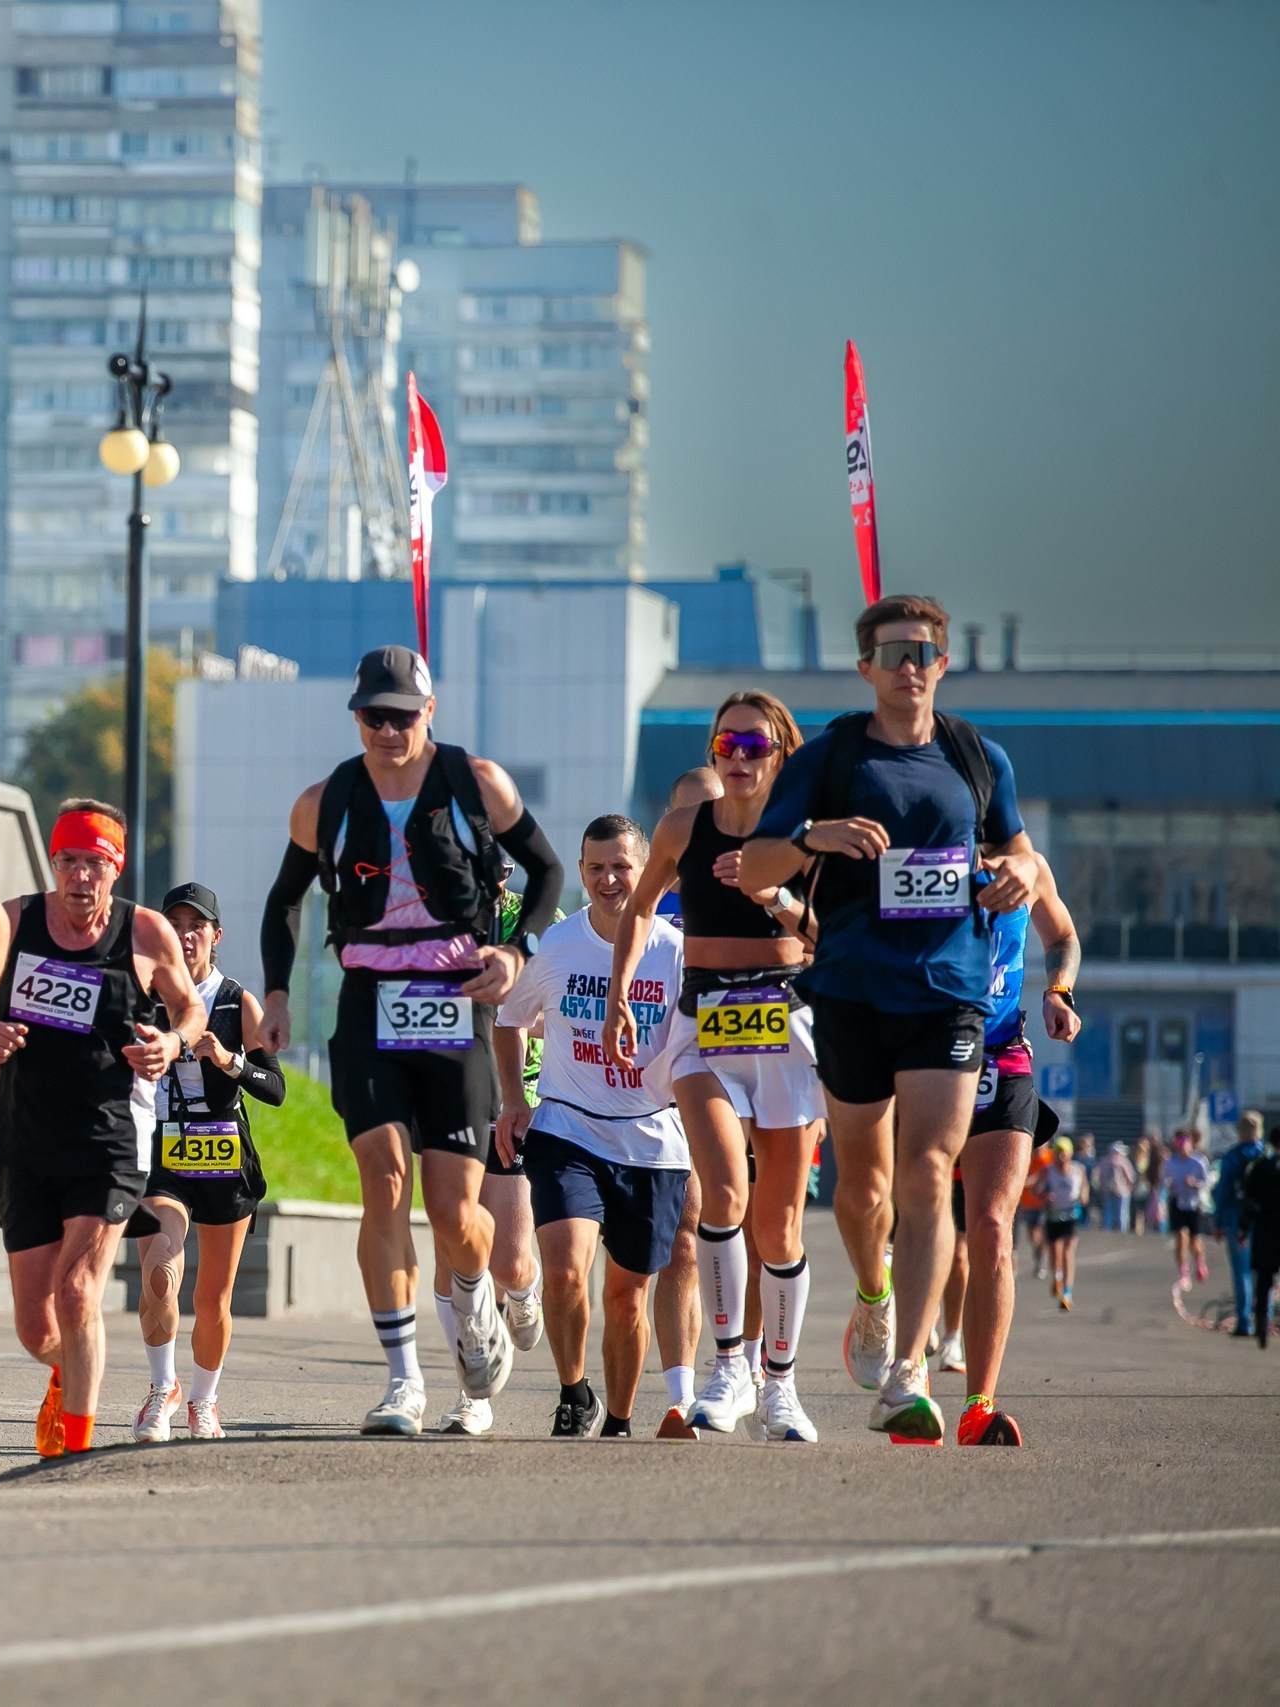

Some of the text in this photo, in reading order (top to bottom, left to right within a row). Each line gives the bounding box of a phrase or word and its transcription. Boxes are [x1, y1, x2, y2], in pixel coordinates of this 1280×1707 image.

[894, 869, 959, 897] 3:29
[16, 975, 92, 1012] 4228
[560, 995, 592, 1020] 45%
[391, 1002, 459, 1029] 3:29
[701, 1008, 786, 1037] 4346
[605, 1067, 617, 1088] С
[168, 1138, 235, 1161] 4319
[713, 1256, 724, 1313] COMPRESSPORT
[778, 1290, 786, 1340] COMPRESSPORT
